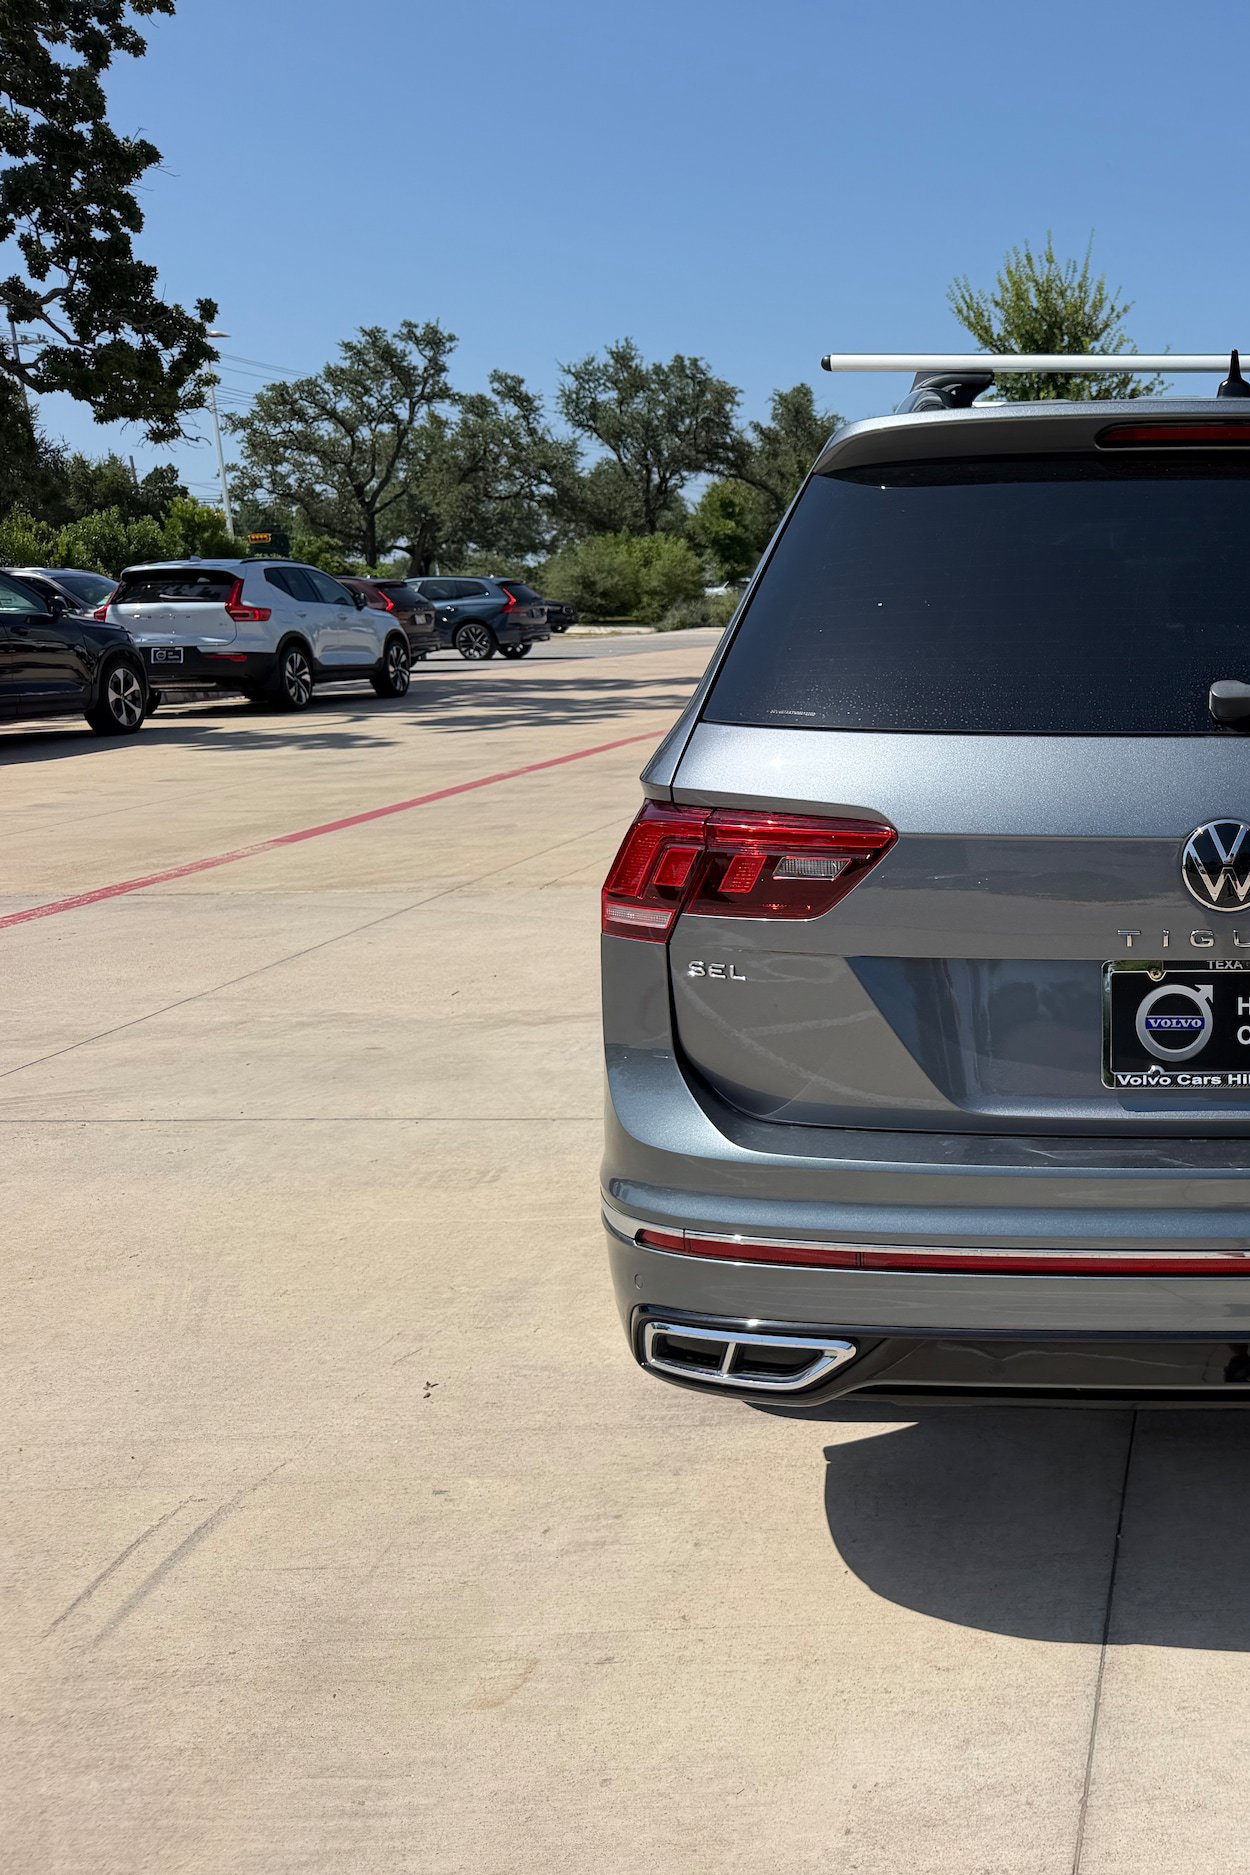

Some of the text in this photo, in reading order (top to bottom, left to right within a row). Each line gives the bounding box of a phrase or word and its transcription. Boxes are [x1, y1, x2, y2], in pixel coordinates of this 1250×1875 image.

[687, 960, 746, 982] SEL
[1149, 1018, 1202, 1028] VOLVO
[1116, 1074, 1173, 1086] Volvo
[1177, 1074, 1222, 1085] Cars
